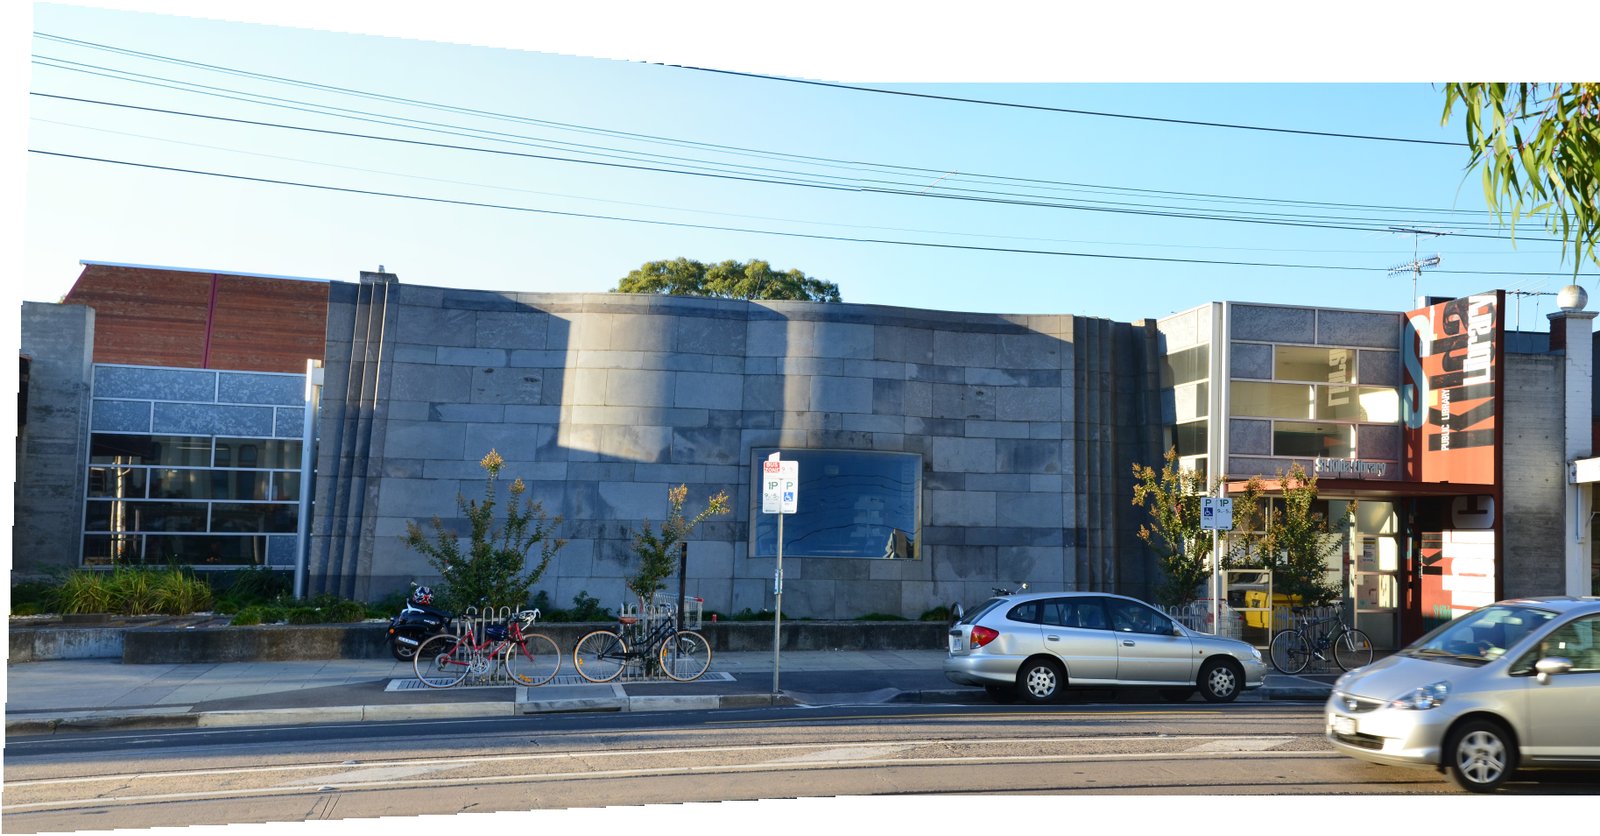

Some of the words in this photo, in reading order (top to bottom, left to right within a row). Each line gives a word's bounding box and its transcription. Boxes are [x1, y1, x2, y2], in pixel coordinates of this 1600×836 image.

[1464, 295, 1497, 386] Library
[1441, 389, 1450, 421] LIBRARY
[1441, 423, 1450, 451] PUBLIC
[768, 481, 778, 490] 1P
[786, 482, 793, 490] P
[1205, 499, 1212, 507] P
[1219, 499, 1229, 507] 1P
